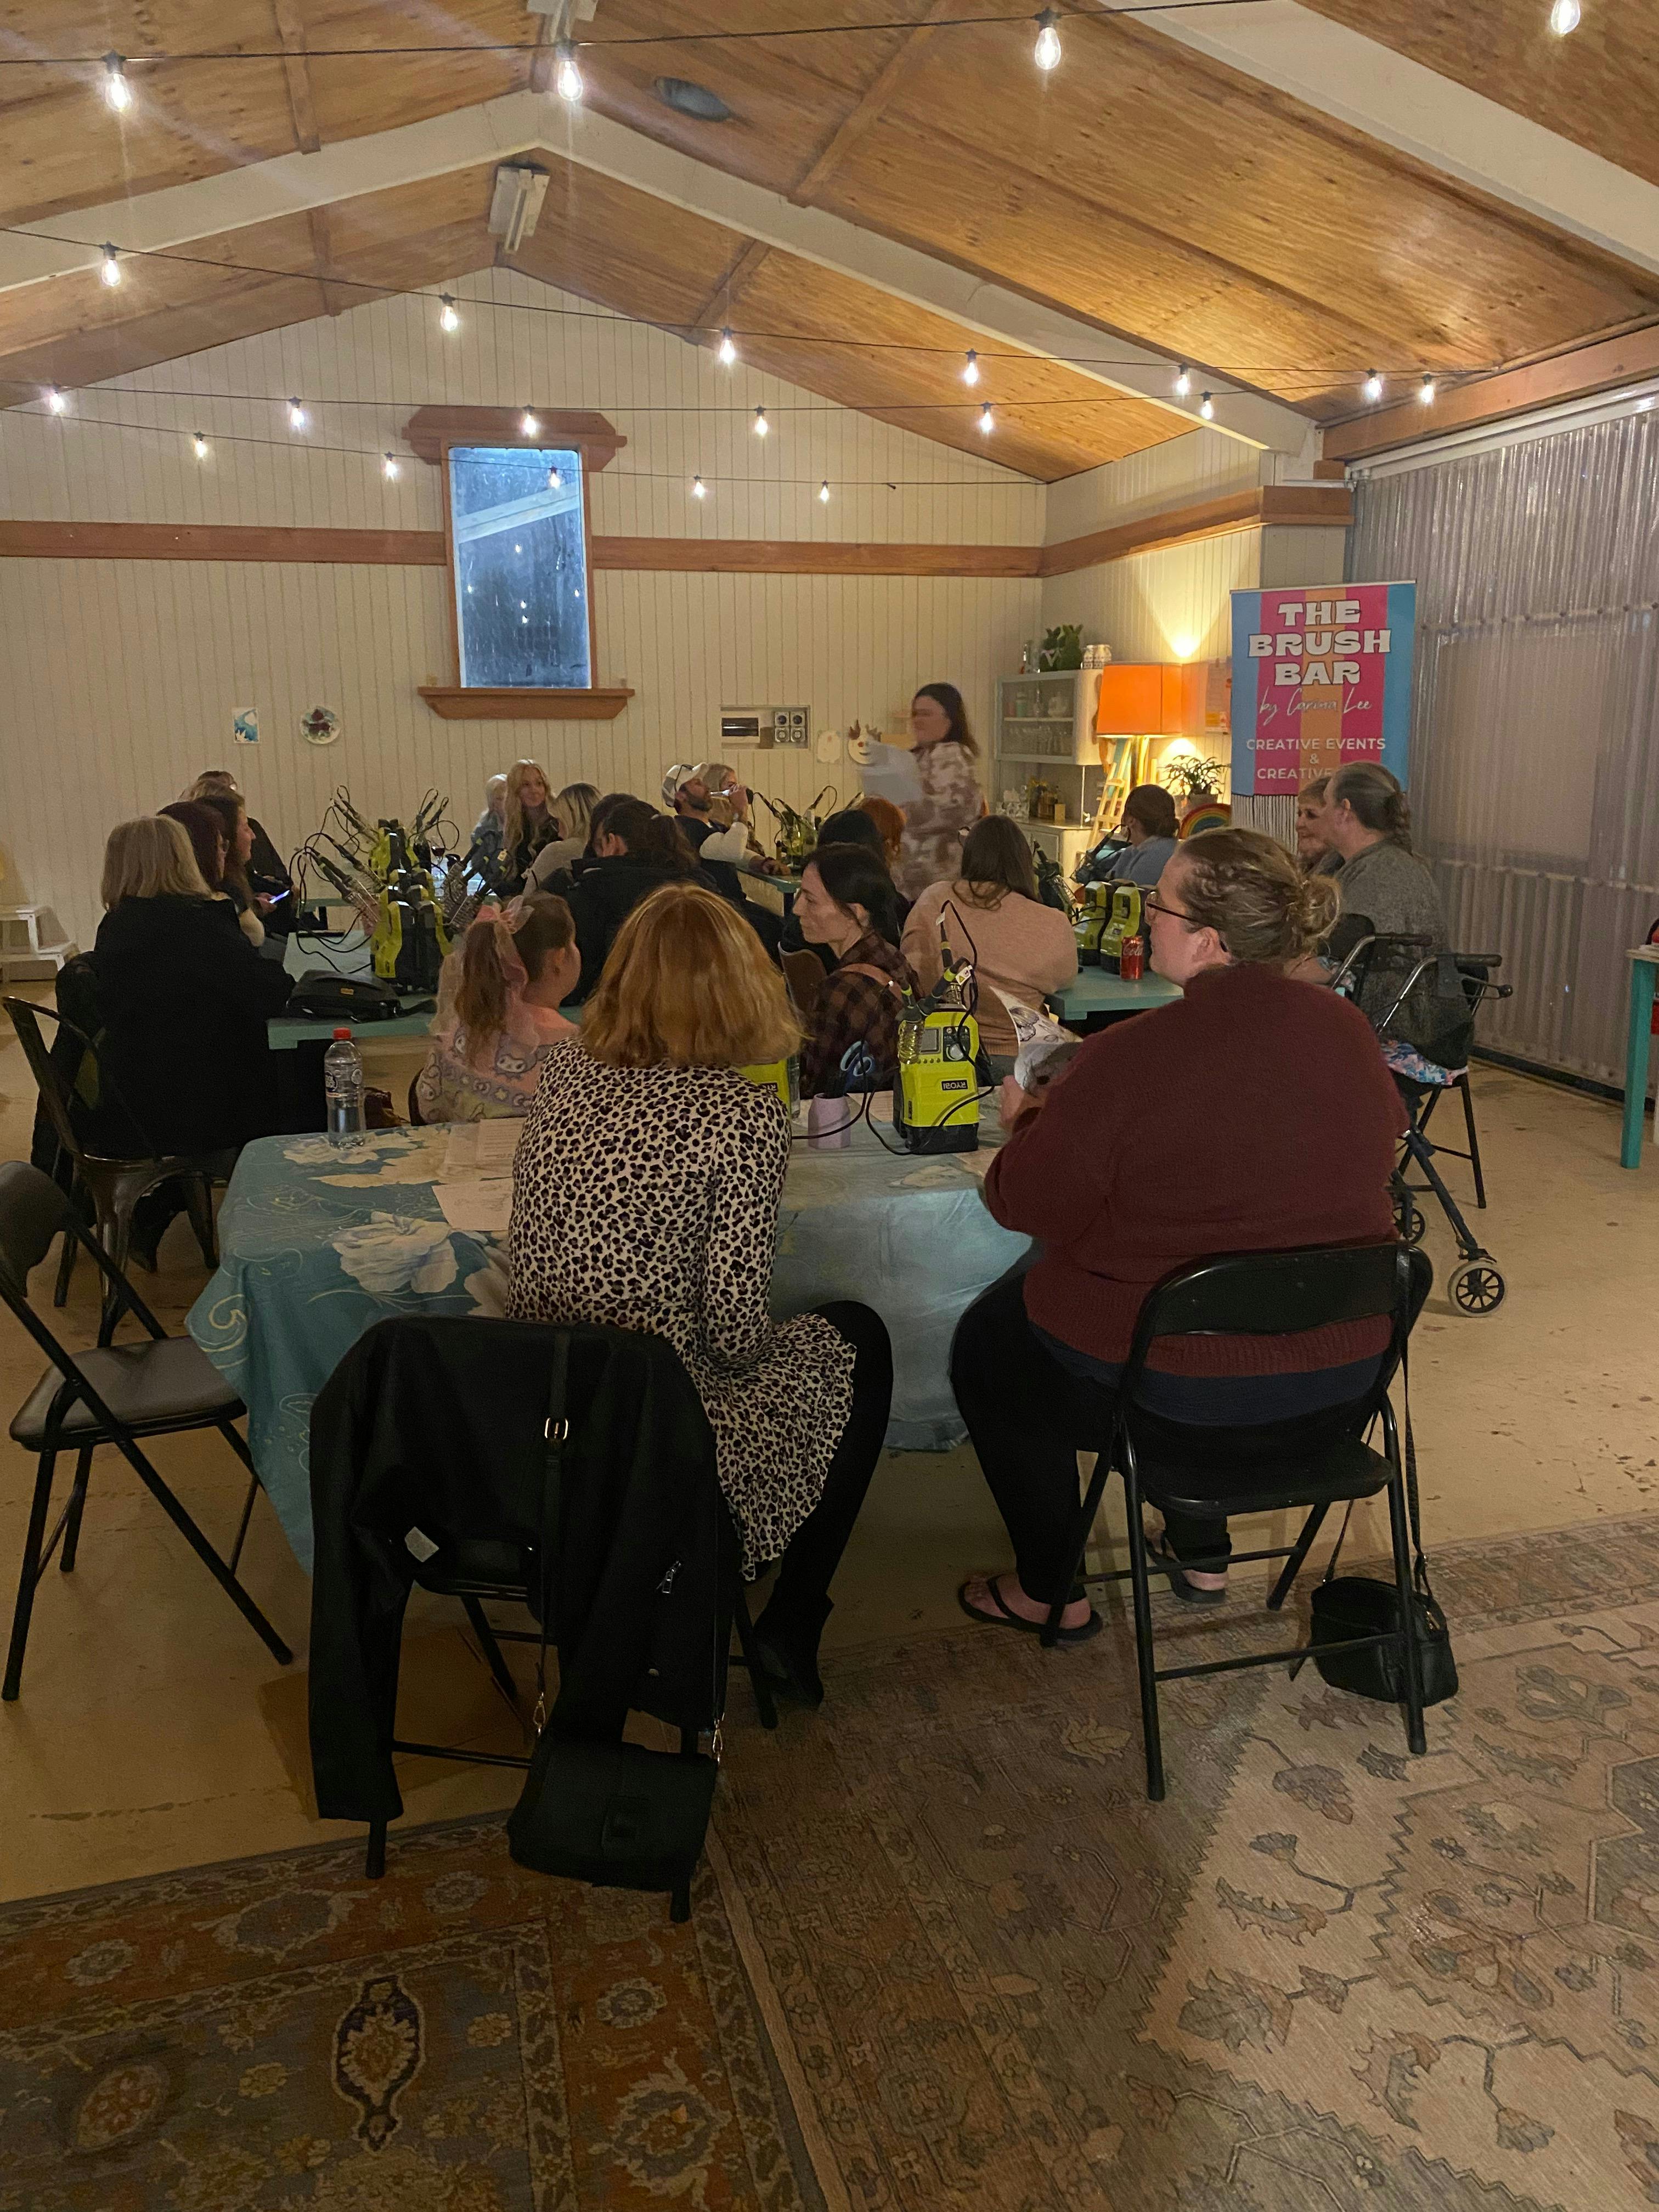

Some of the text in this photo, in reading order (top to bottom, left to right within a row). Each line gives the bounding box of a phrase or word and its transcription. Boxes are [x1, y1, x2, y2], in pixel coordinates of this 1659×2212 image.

[1278, 600, 1361, 627] THE
[1248, 629, 1391, 657] BRUSH
[1274, 661, 1361, 686] BAR
[1260, 686, 1278, 726] by
[1344, 687, 1372, 713] Lee
[1246, 738, 1386, 751] CREATIVE EVENTS
[1310, 753, 1319, 764] &
[943, 1081, 967, 1090] RYOBI
